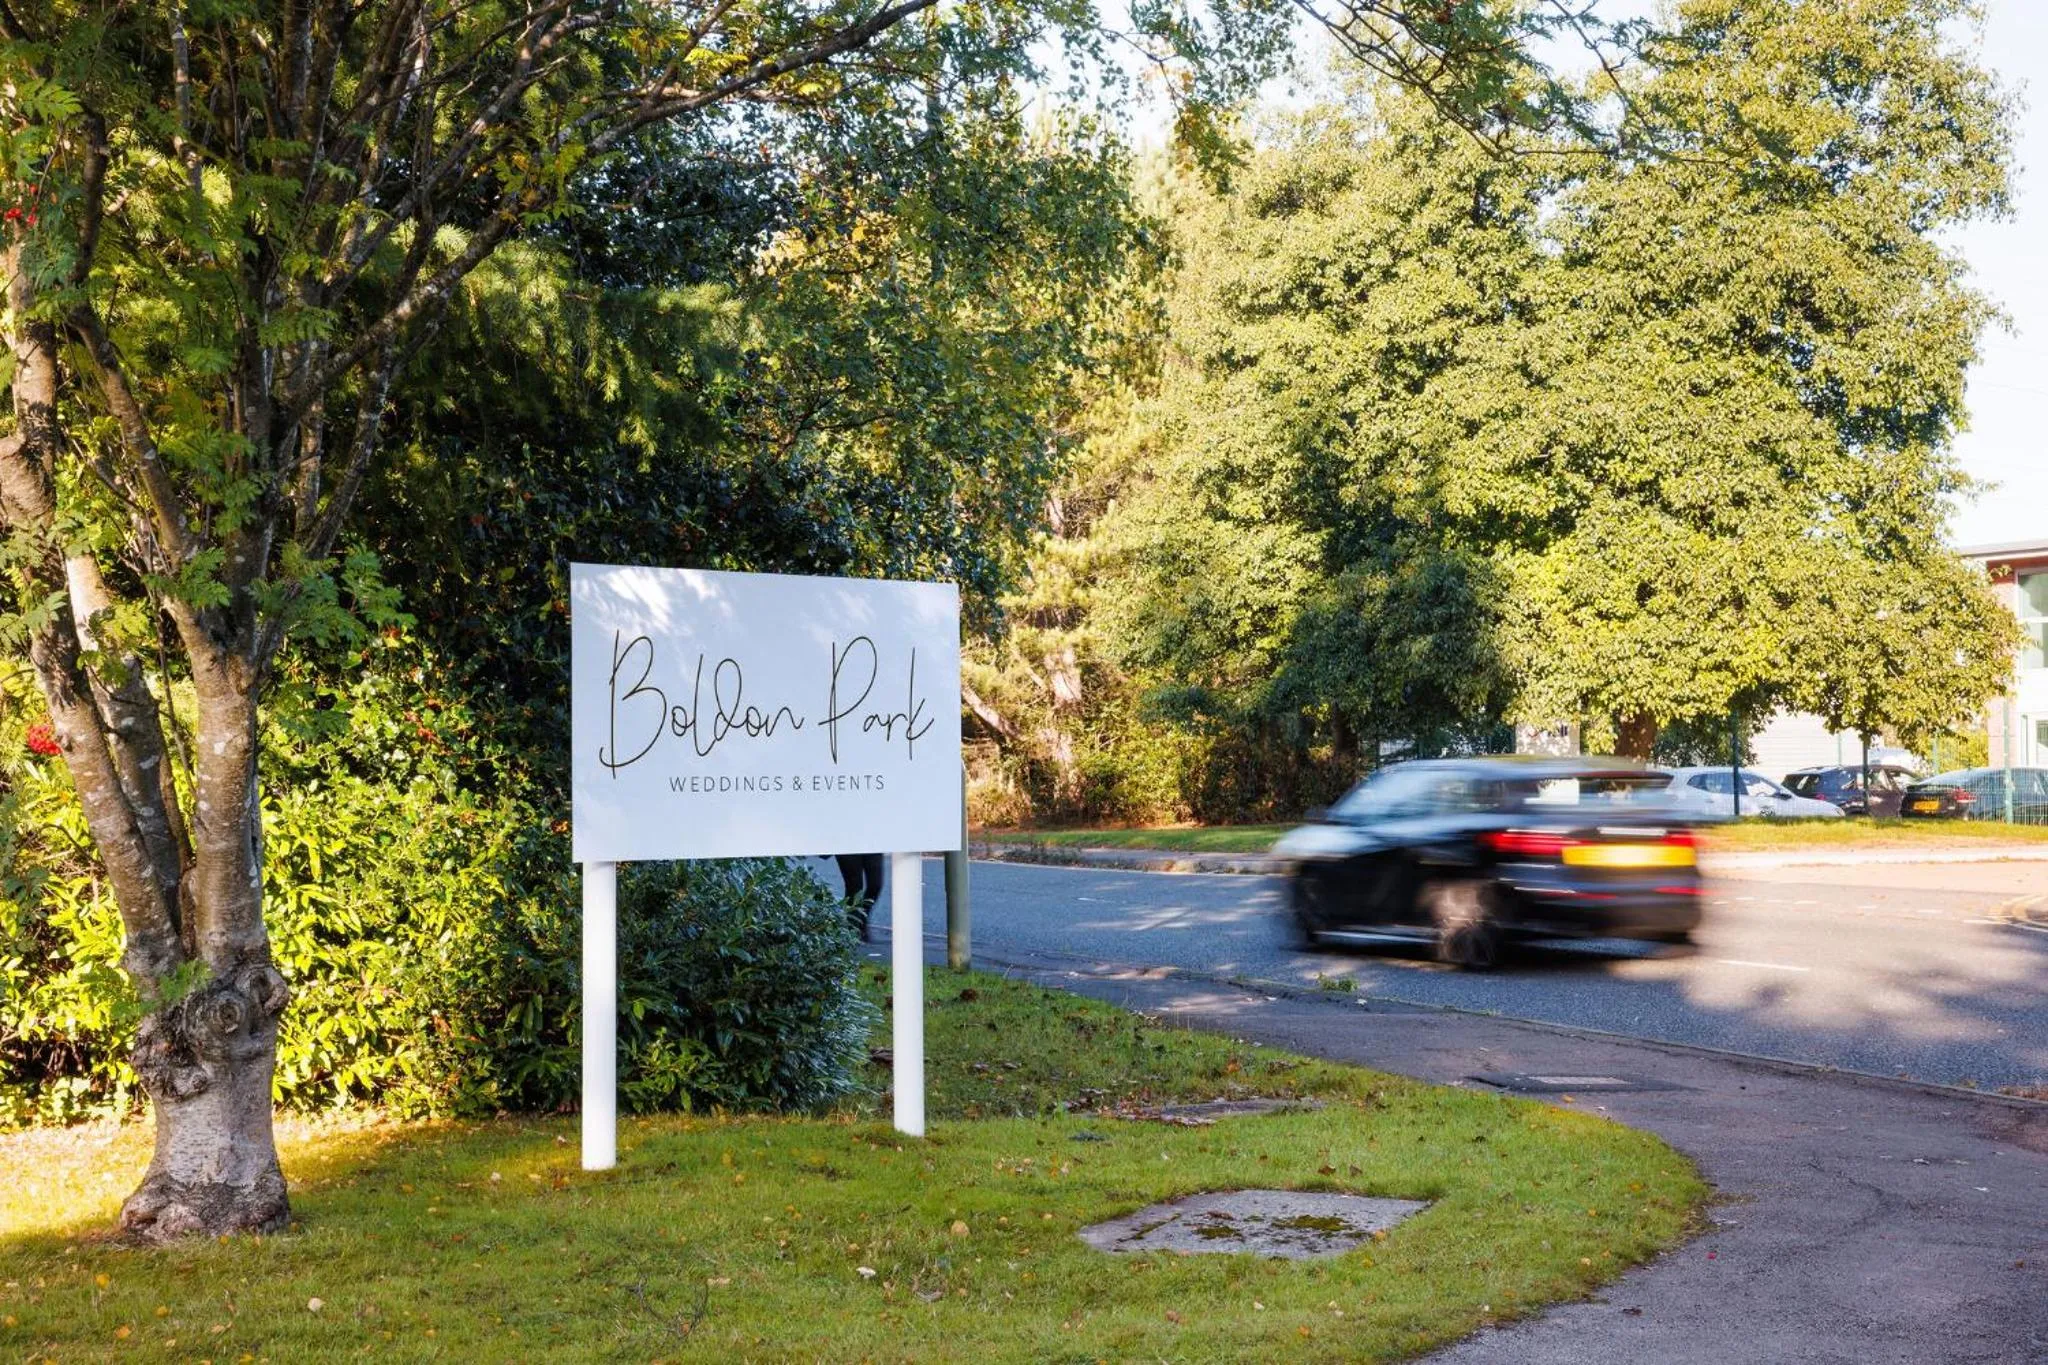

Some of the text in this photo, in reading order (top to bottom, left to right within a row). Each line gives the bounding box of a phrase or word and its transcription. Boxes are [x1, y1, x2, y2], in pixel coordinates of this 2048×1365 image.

[599, 628, 935, 779] Boldon Park
[669, 774, 886, 793] WEDDINGS & EVENTS
